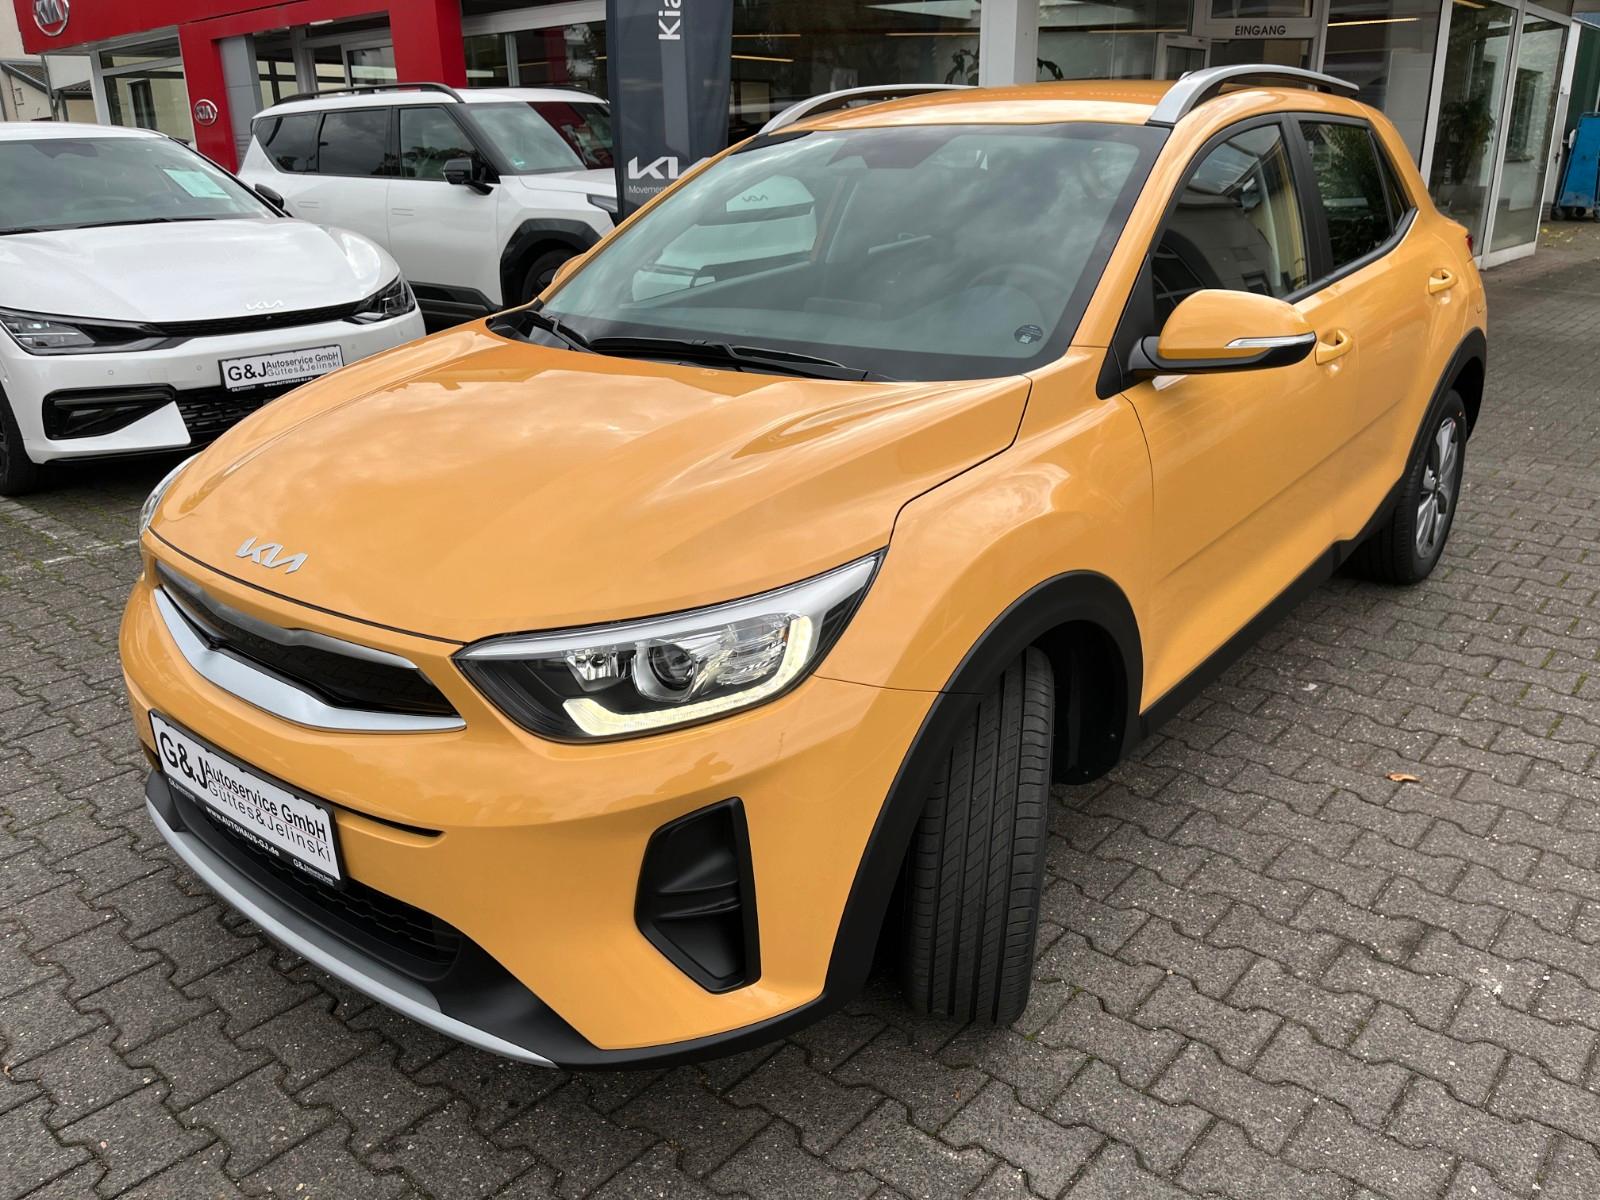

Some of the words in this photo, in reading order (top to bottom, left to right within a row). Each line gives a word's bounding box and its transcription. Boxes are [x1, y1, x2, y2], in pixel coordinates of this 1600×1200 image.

[1234, 25, 1286, 36] EINGANG
[246, 299, 284, 310] KIA
[266, 355, 313, 369] Autoservice
[315, 352, 339, 362] GmbH
[228, 362, 266, 382] G&J
[235, 536, 308, 575] KIA
[160, 732, 207, 789] G&J
[205, 760, 278, 816] Autoservice
[281, 804, 327, 842] GmbH
